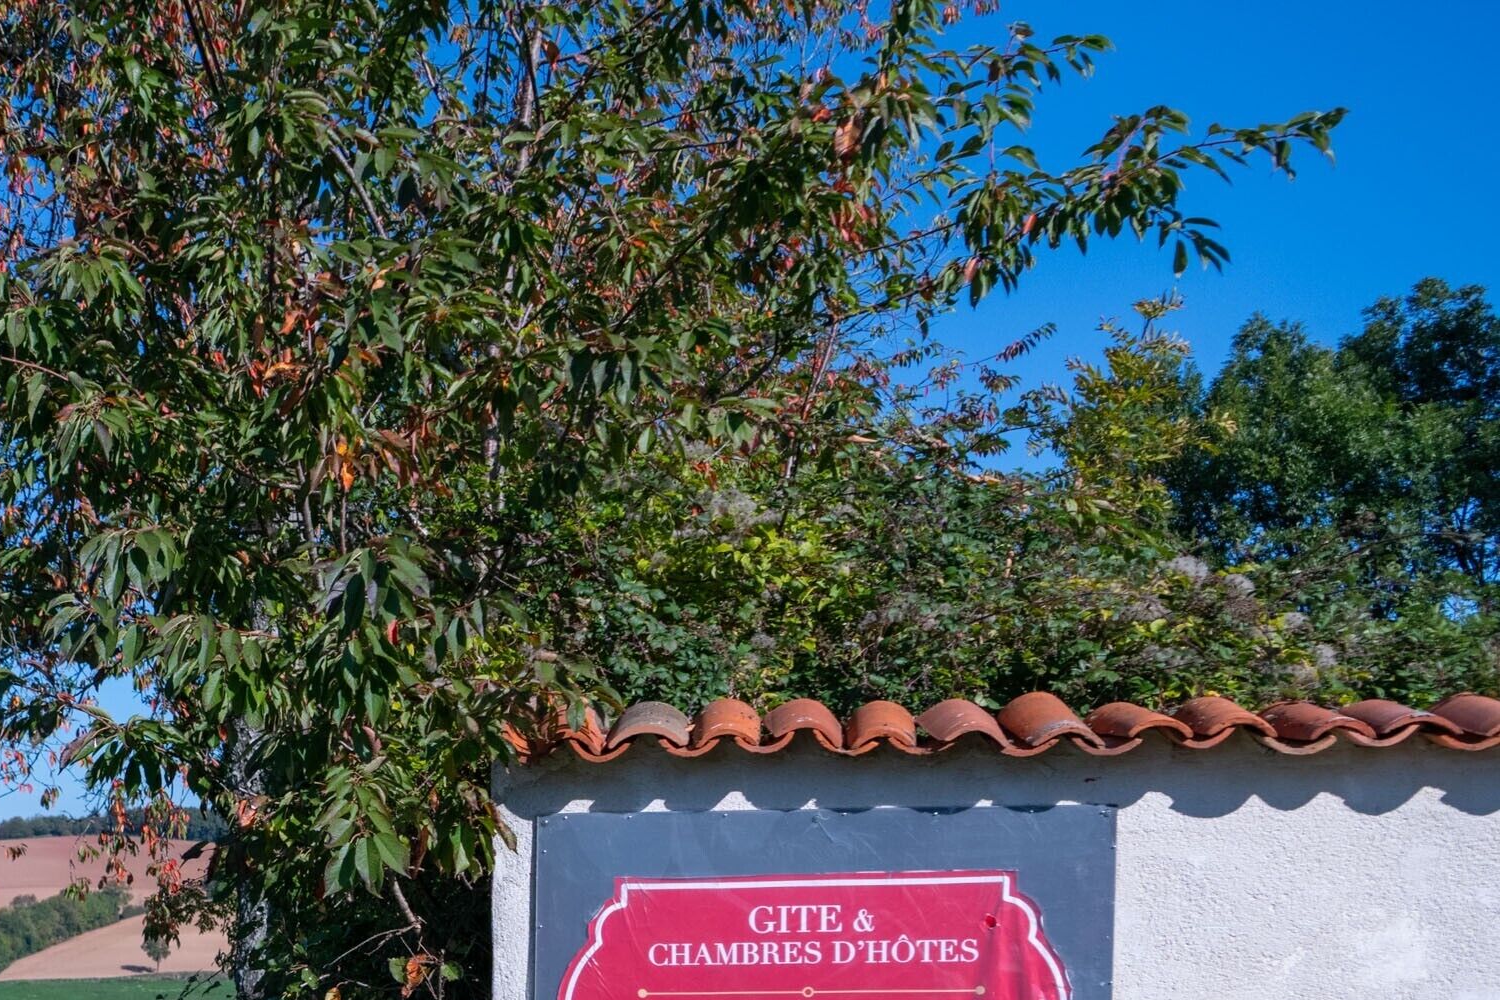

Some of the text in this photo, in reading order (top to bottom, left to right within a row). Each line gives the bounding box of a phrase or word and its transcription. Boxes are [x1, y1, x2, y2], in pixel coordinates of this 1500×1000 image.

[748, 905, 874, 934] GITE &
[648, 934, 979, 966] CHAMBRES D’HÔTES
